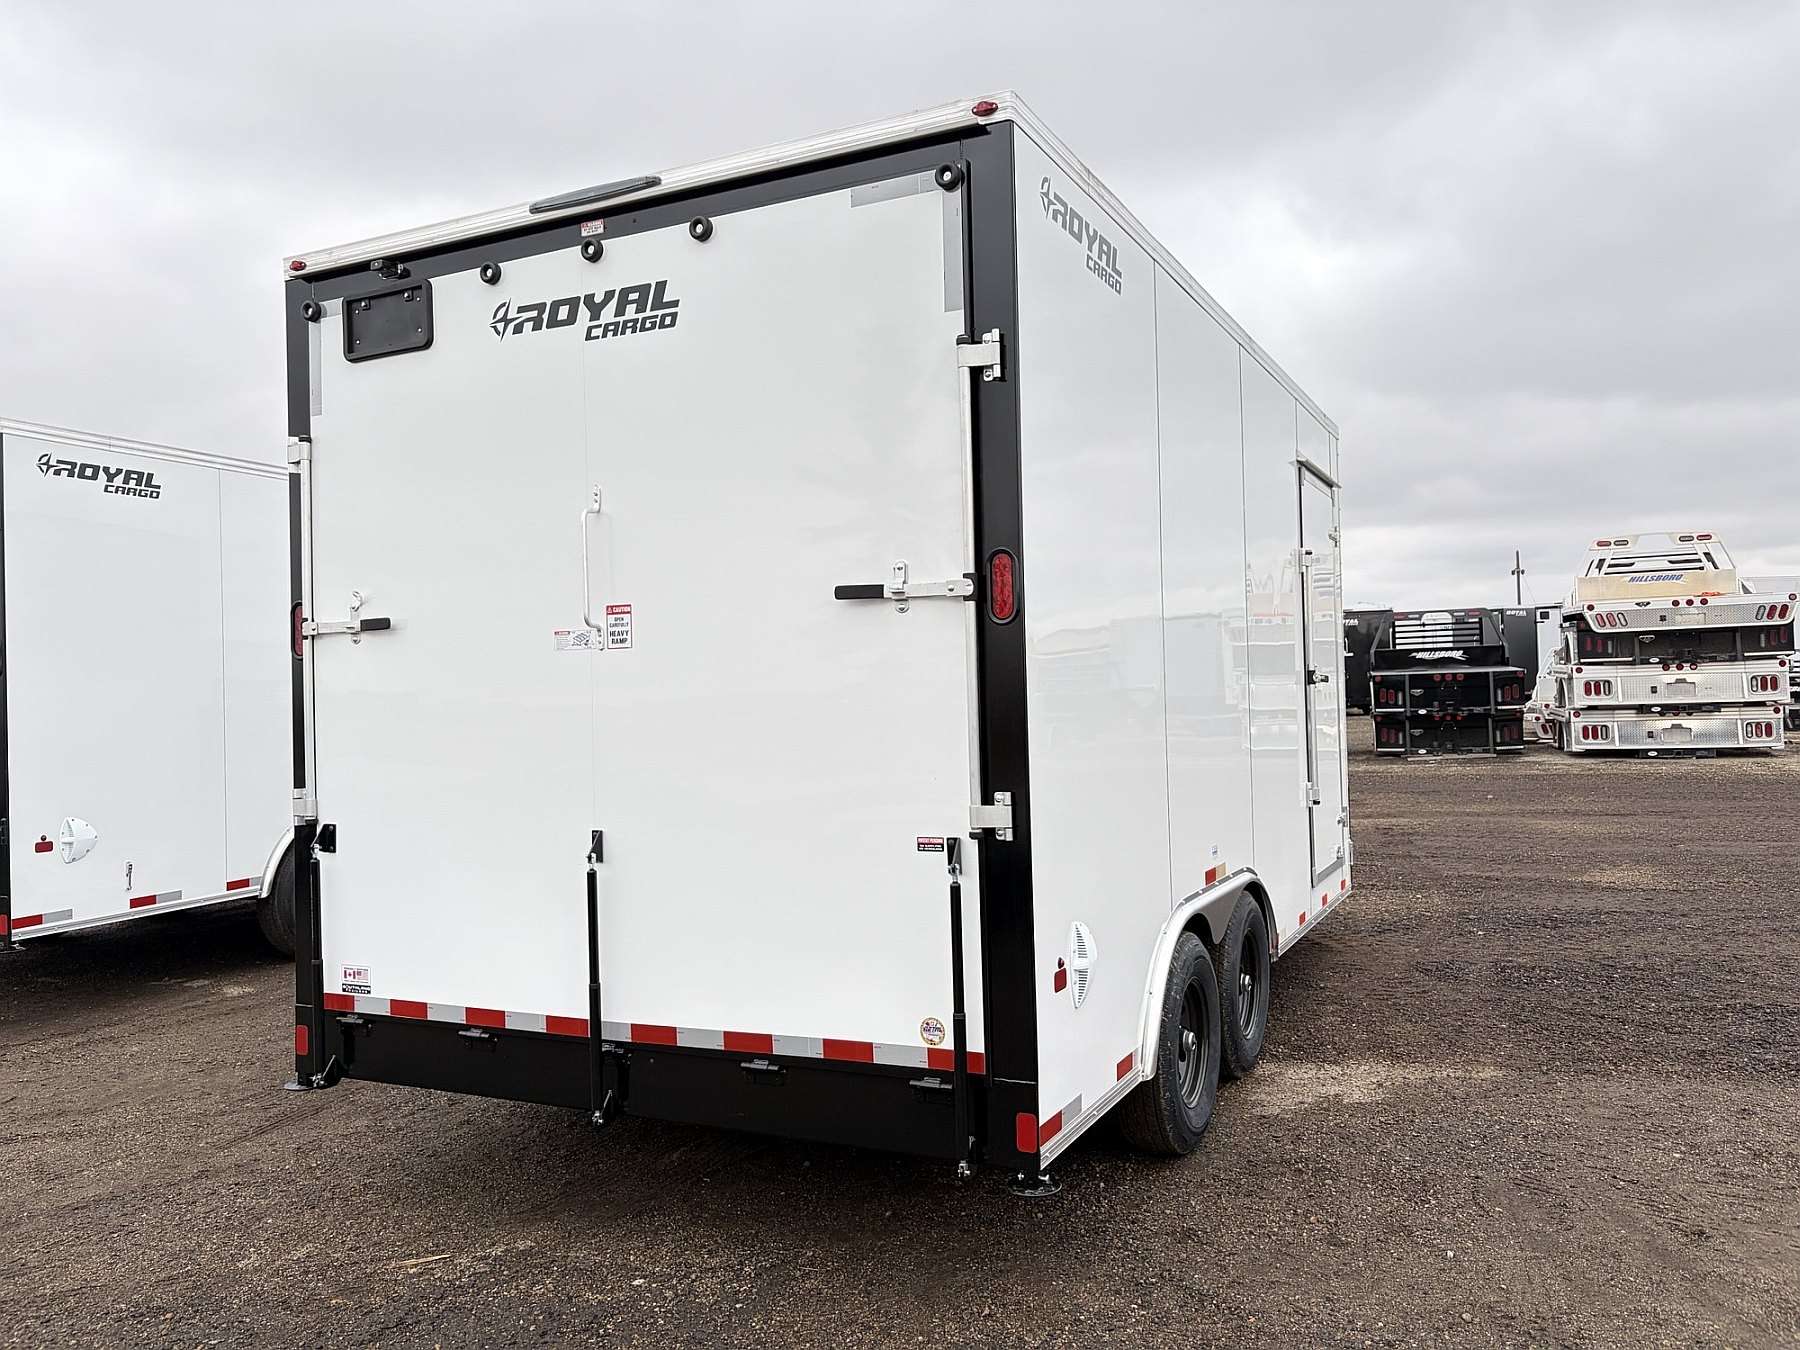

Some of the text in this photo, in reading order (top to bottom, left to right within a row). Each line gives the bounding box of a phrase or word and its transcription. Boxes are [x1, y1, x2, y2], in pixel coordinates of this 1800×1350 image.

[1052, 191, 1122, 279] ROYAL
[1086, 253, 1121, 296] CARGO
[512, 279, 680, 335] ROYAL
[584, 311, 679, 341] CARGO
[53, 459, 161, 489] ROYAL
[103, 484, 161, 499] CARGO
[1628, 574, 1684, 583] HILLSBORO
[1416, 650, 1464, 659] HILLSBORO
